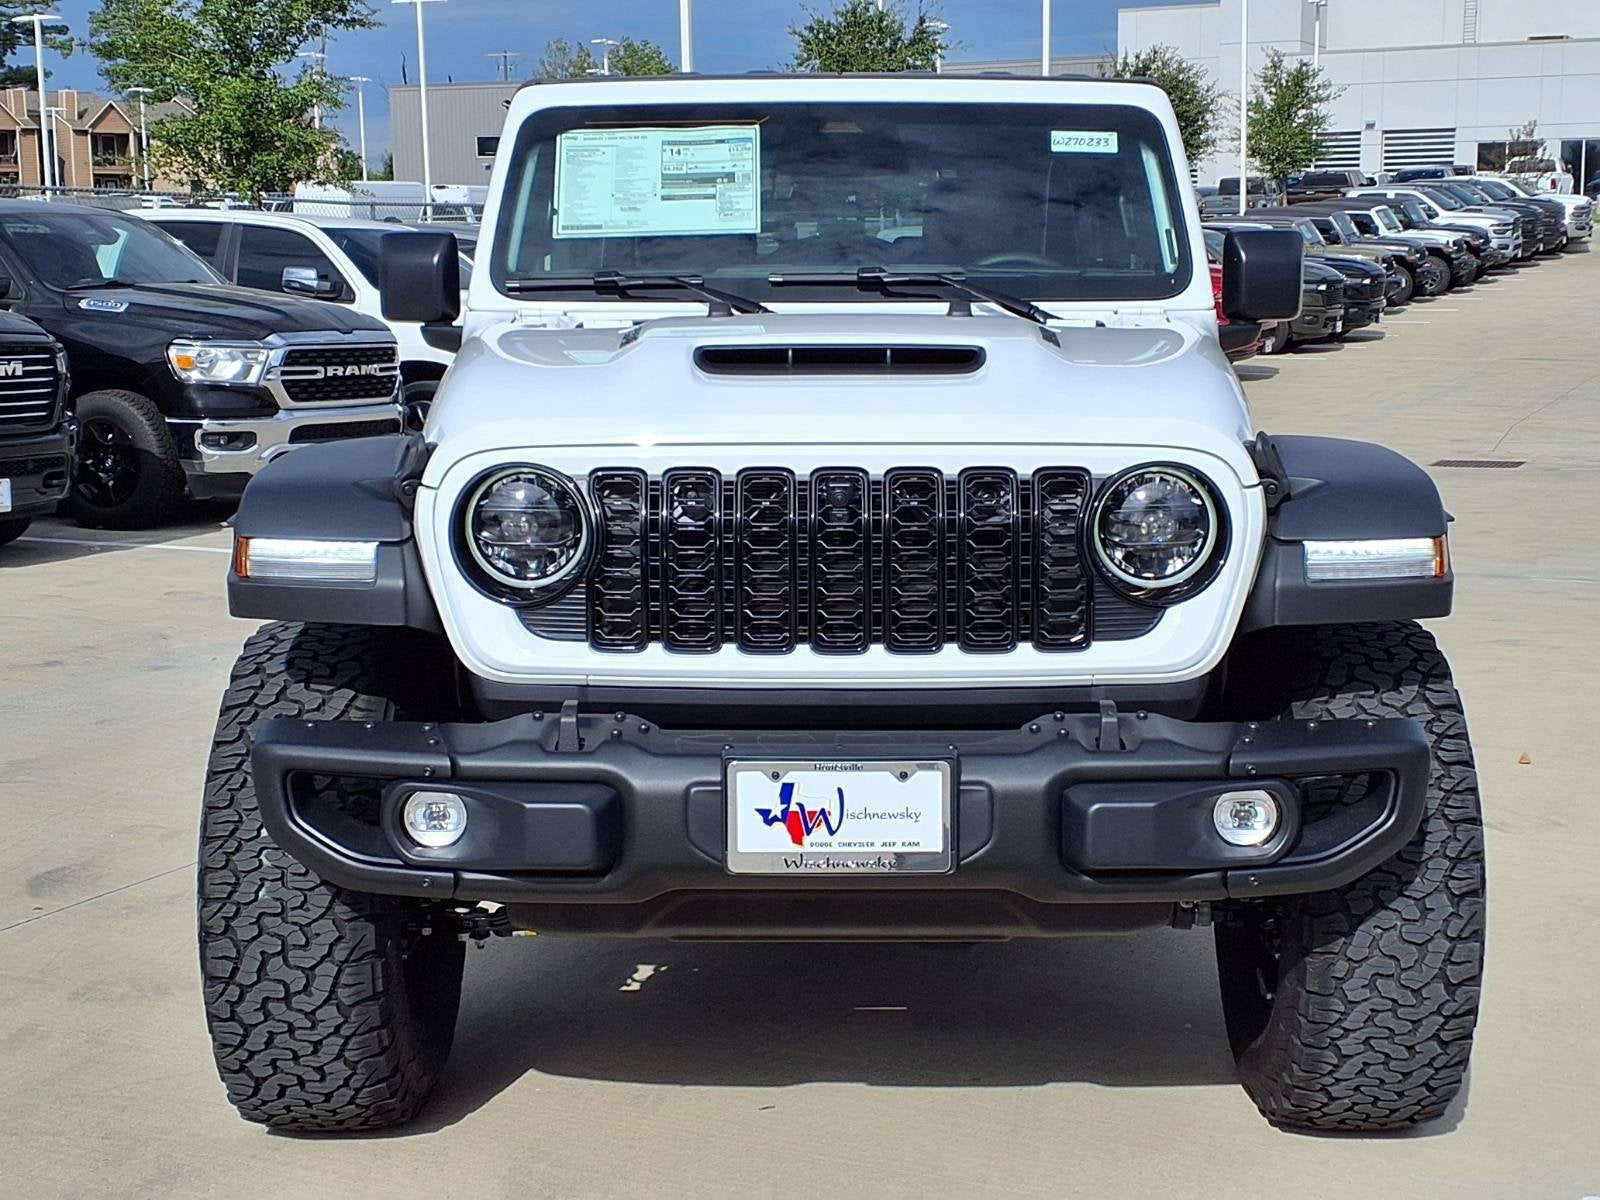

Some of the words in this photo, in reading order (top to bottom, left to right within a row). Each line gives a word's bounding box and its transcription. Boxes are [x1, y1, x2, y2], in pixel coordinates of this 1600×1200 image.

[670, 148, 681, 157] 14
[326, 364, 377, 377] RAM
[783, 853, 897, 871] Wischnewsky
